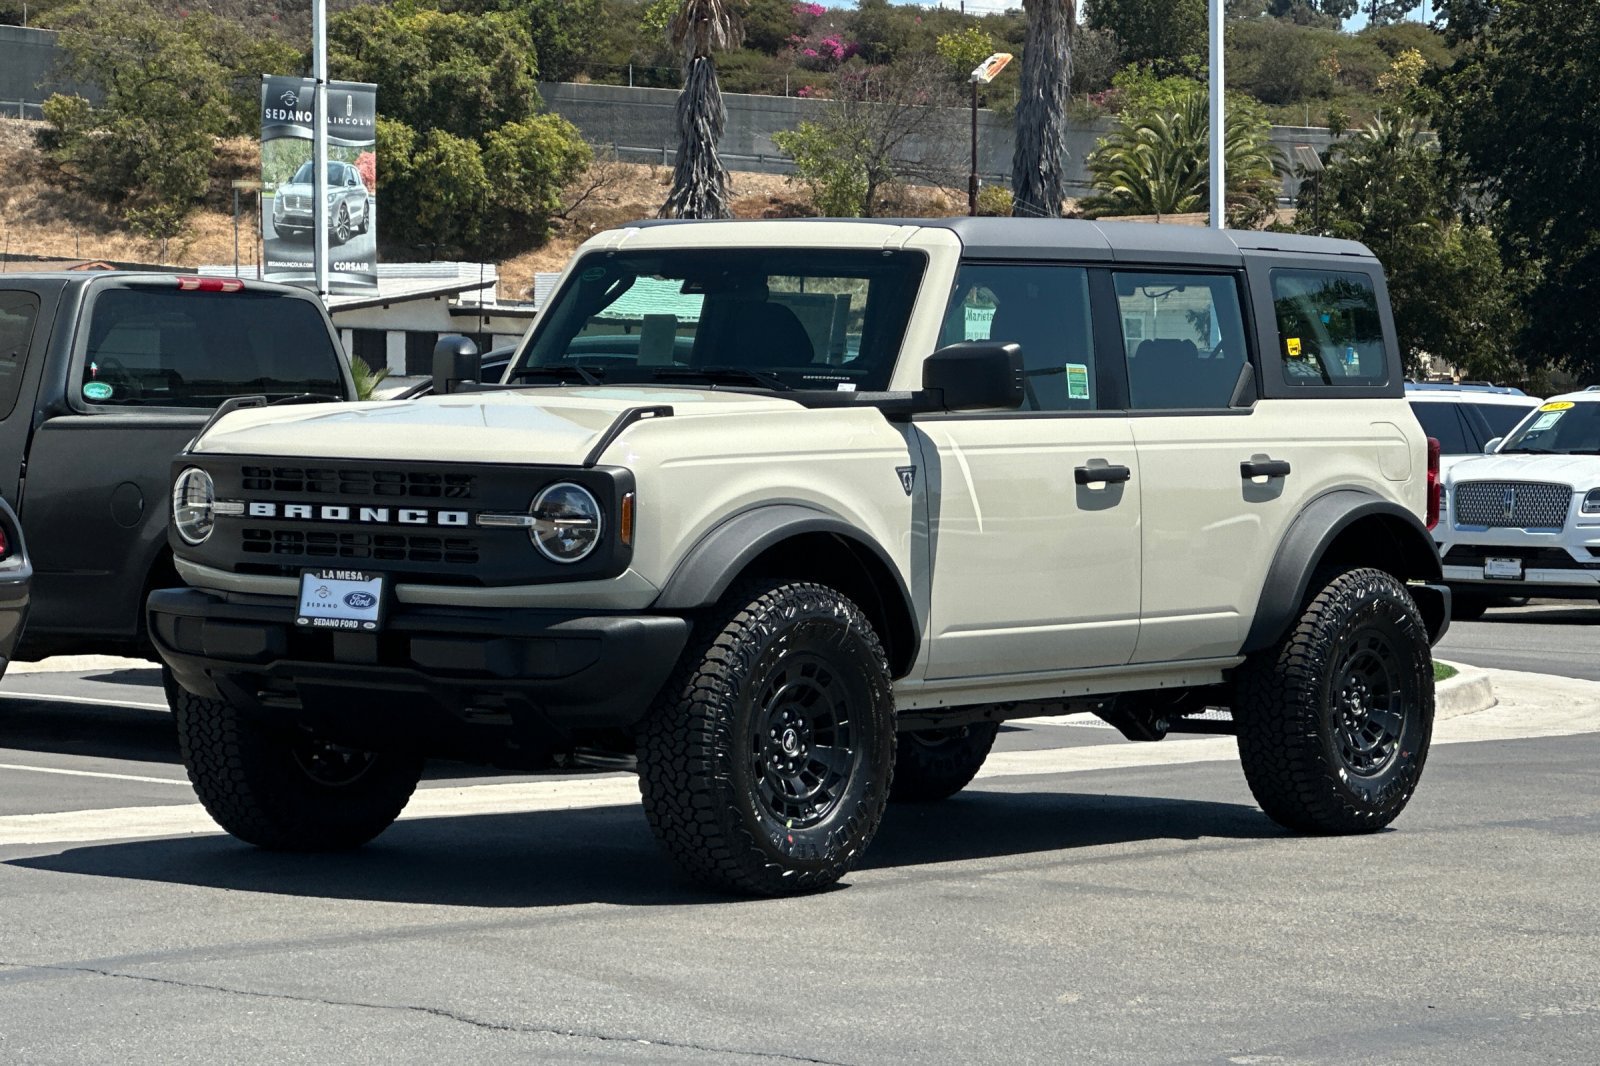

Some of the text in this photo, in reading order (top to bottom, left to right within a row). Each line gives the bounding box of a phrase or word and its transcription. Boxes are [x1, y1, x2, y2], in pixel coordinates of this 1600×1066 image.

[265, 108, 313, 123] SEDANO
[327, 116, 372, 127] LINCOLN
[333, 261, 369, 272] CORSAIR
[249, 502, 469, 526] BRONCO
[322, 569, 363, 581] LA MESA
[306, 601, 338, 609] SEDANO
[349, 593, 371, 607] Ford
[313, 617, 339, 628] SEDANO
[339, 619, 359, 629] FORD
